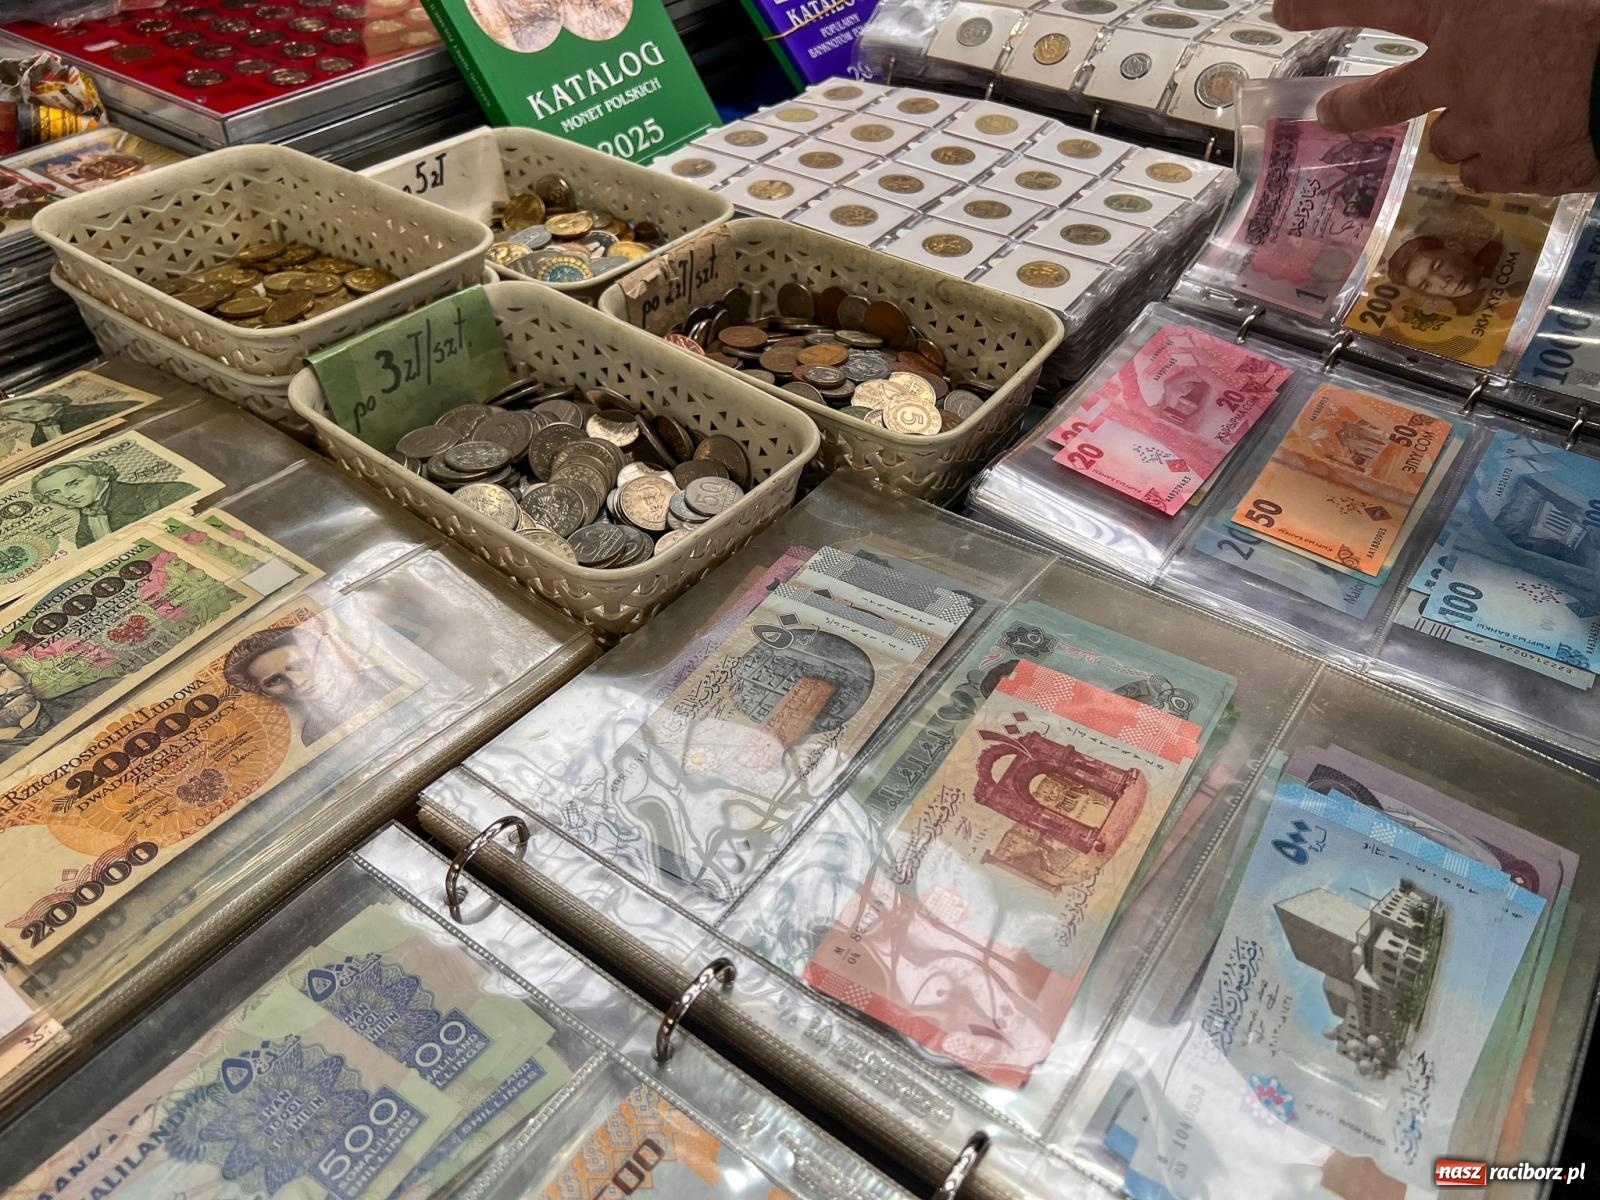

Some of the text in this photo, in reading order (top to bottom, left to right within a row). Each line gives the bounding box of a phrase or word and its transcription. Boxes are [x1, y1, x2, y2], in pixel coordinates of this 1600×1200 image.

[526, 41, 666, 120] KATALOG
[560, 77, 662, 134] MONET POLSKICH
[1359, 284, 1400, 329] 200
[1471, 312, 1493, 337] ЭКИ
[1496, 252, 1520, 286] СОМ
[353, 395, 377, 433] po
[1216, 390, 1246, 412] 20
[1067, 443, 1104, 471] 20
[1389, 425, 1418, 448] 50
[1245, 498, 1282, 528] 50
[86, 543, 152, 581] LUDOWA
[12, 560, 153, 652] 10000
[1437, 581, 1484, 622] 100
[2, 718, 144, 806] RZECZPOSPOLITA
[134, 679, 208, 724] LUDOWA
[65, 693, 220, 800] 20000
[131, 736, 203, 787] ZŁOTYCH
[19, 841, 159, 949] 20000
[344, 1001, 371, 1025] HAN
[368, 1010, 400, 1042] HILIN
[414, 1020, 467, 1068] 00
[318, 1098, 398, 1181] 500
[338, 1110, 411, 1191] SOMALILAND
[347, 1117, 420, 1197] SHILLINGS
[608, 1138, 666, 1197] 00
